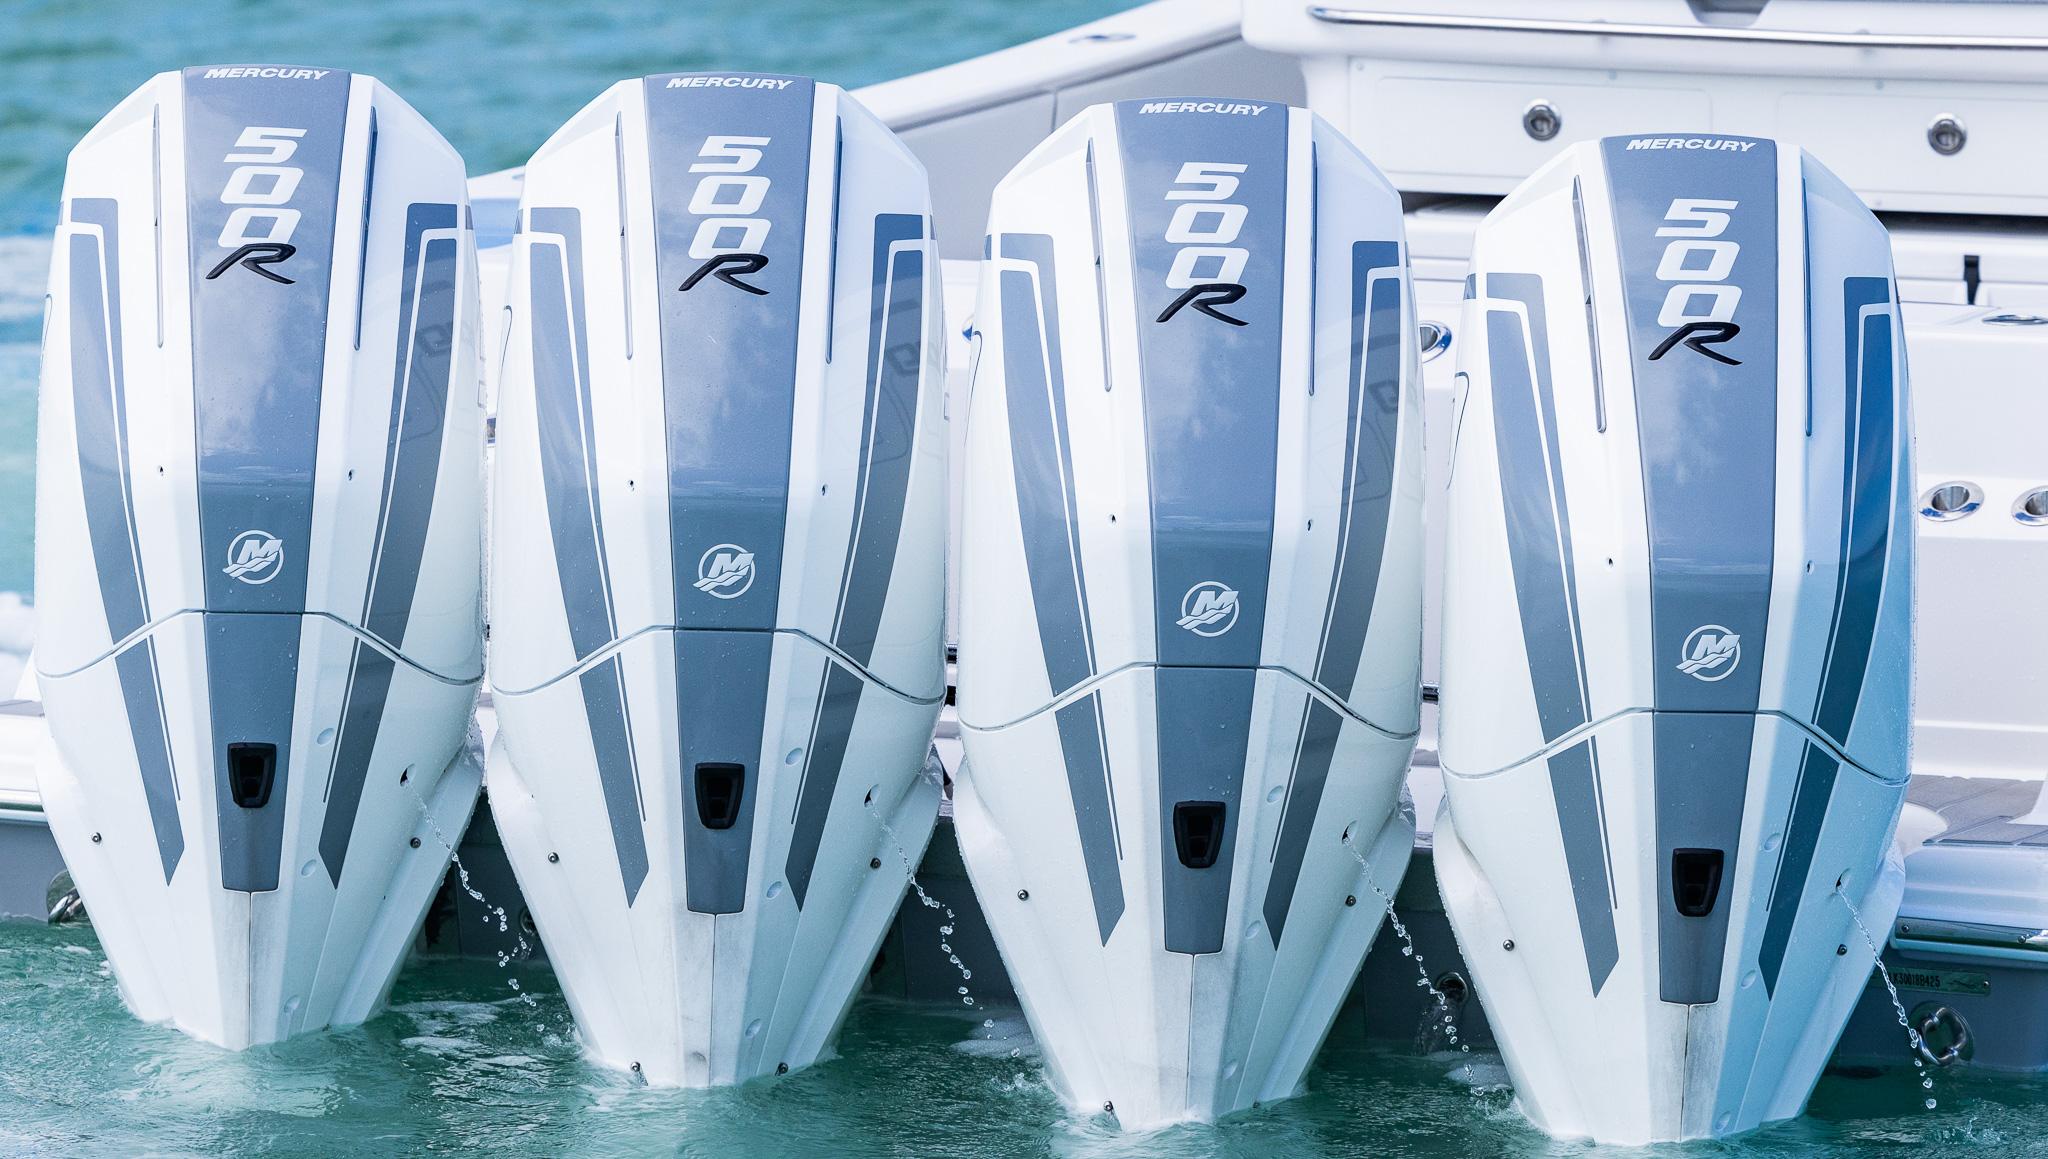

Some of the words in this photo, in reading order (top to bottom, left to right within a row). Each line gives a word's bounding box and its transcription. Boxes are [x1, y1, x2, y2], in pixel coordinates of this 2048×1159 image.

[203, 67, 330, 80] MERCURY
[665, 76, 794, 90] MERCURY
[1138, 102, 1269, 116] MERCURY
[1626, 138, 1756, 153] MERCURY
